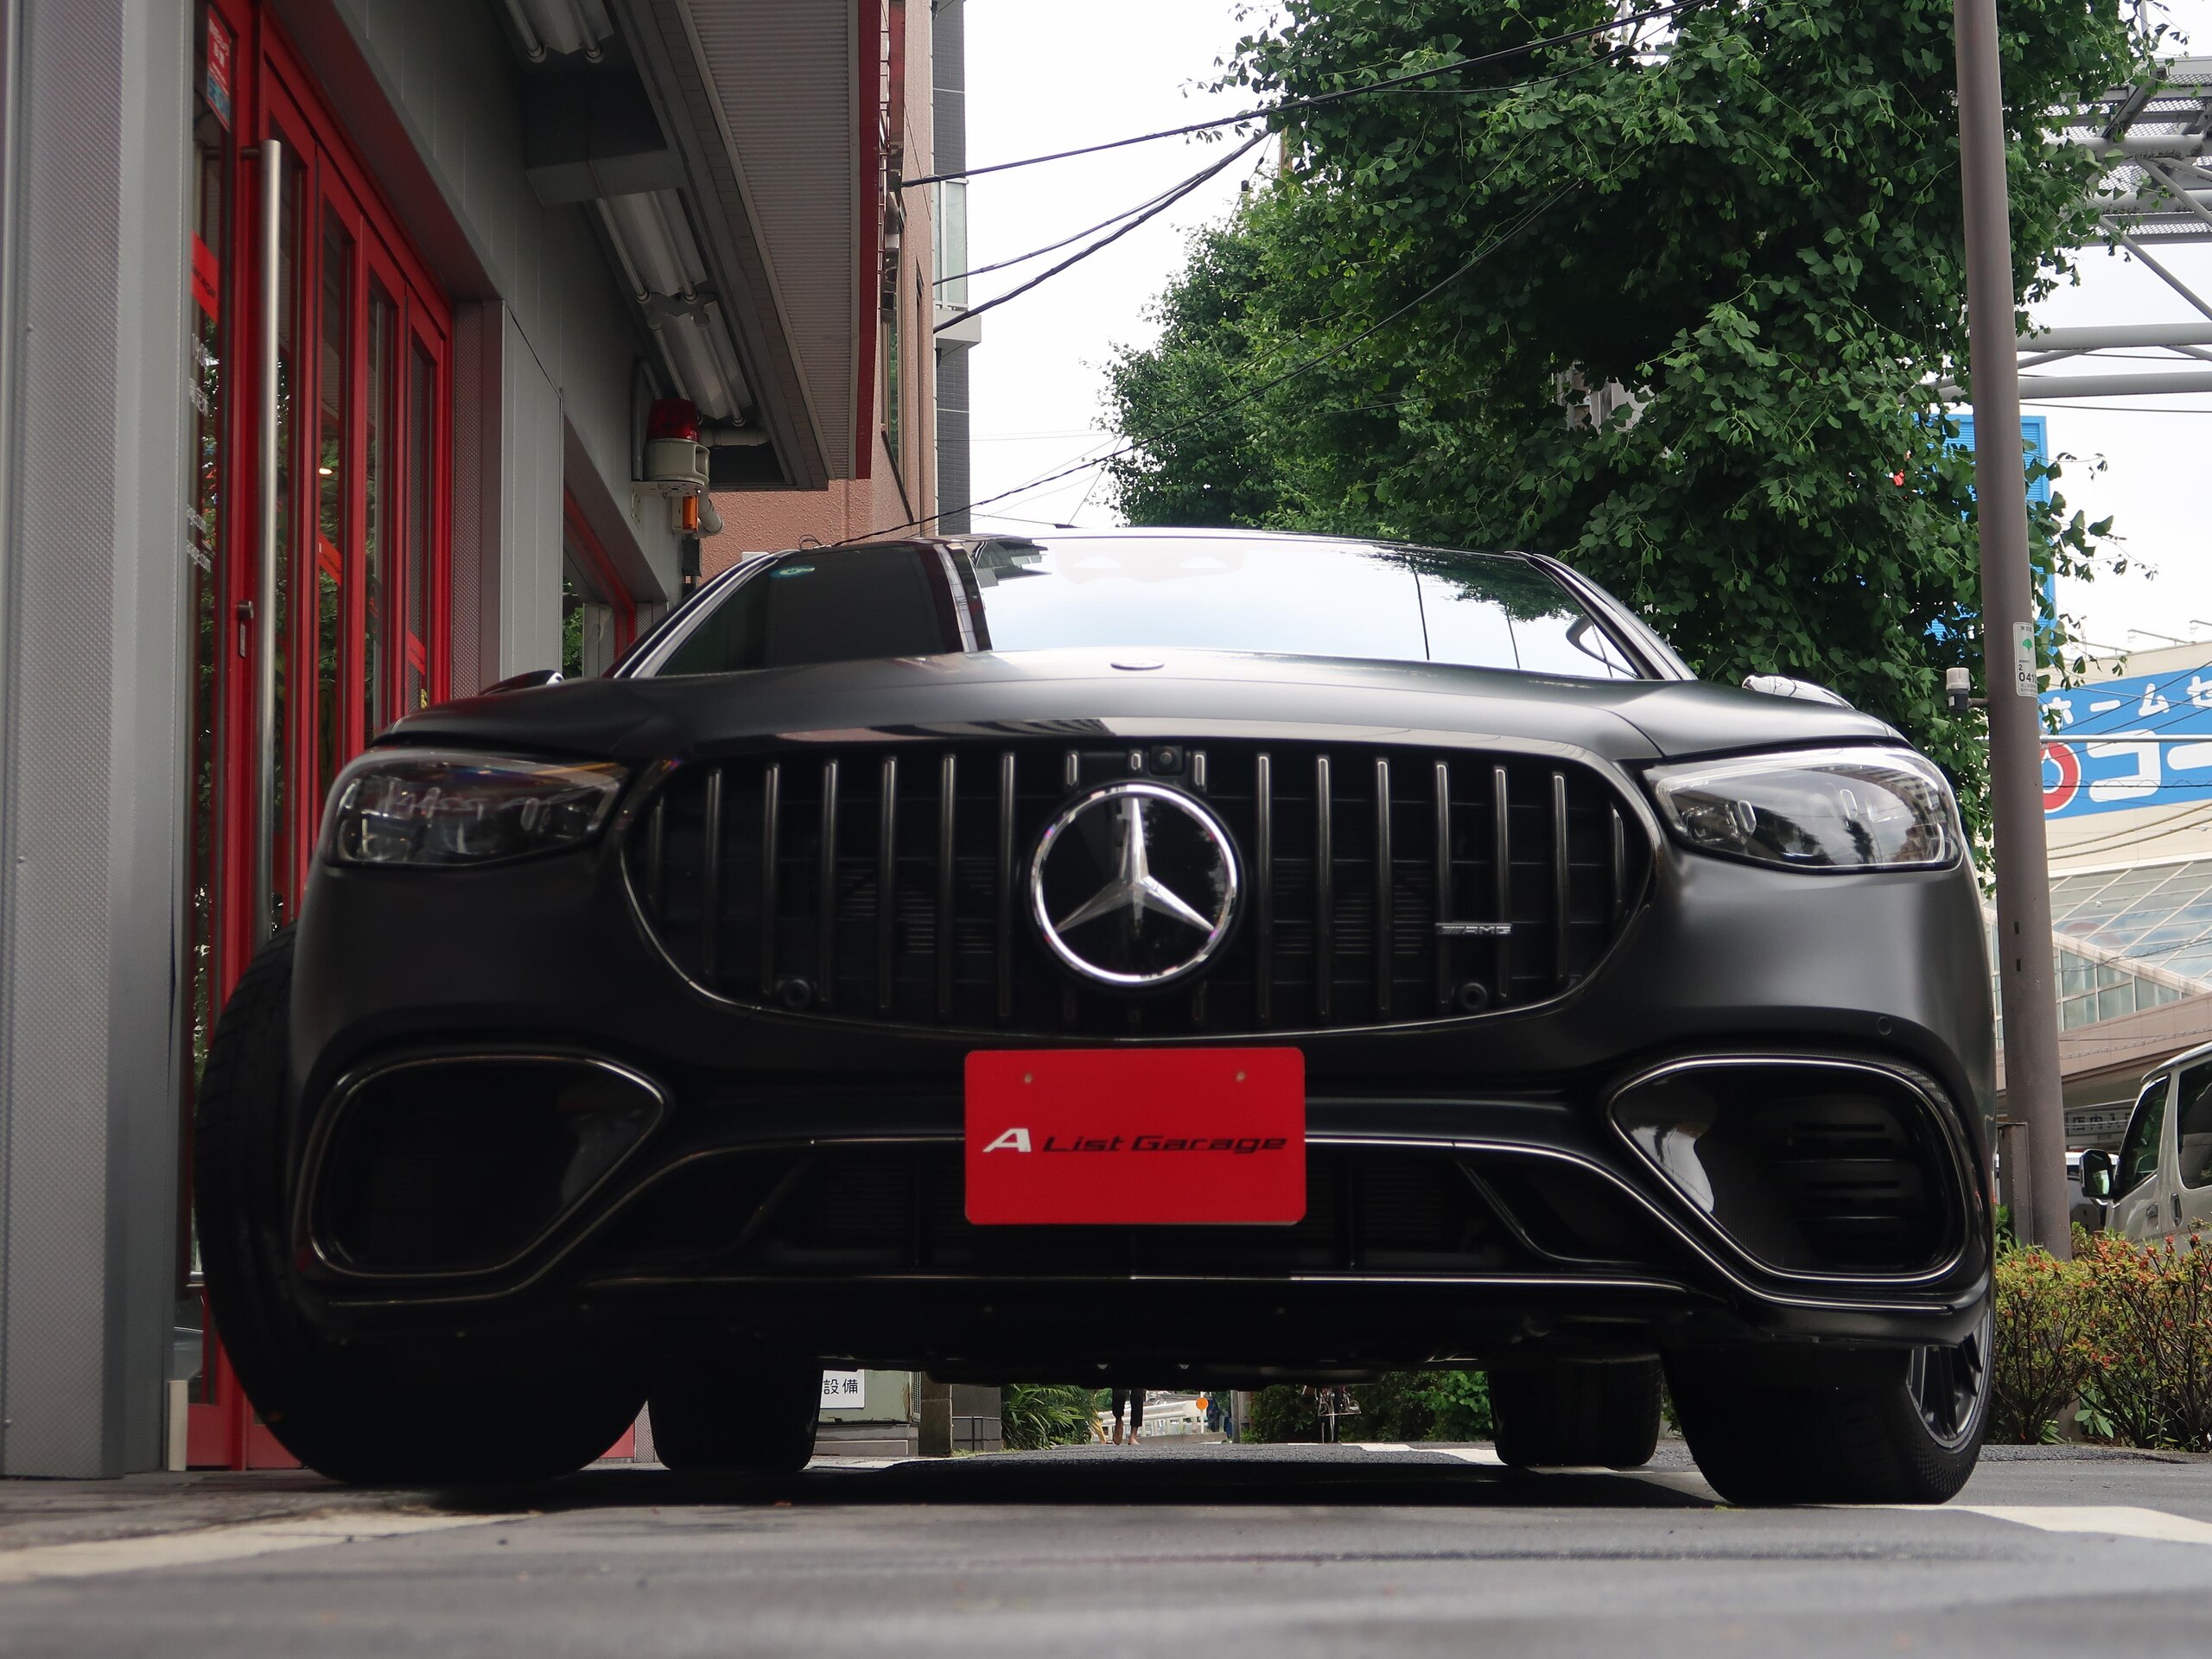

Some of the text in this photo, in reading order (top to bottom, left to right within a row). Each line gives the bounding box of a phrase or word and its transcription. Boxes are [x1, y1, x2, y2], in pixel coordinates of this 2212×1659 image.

[982, 1128, 1287, 1154] A List Garage
[823, 1378, 858, 1395] 設備
